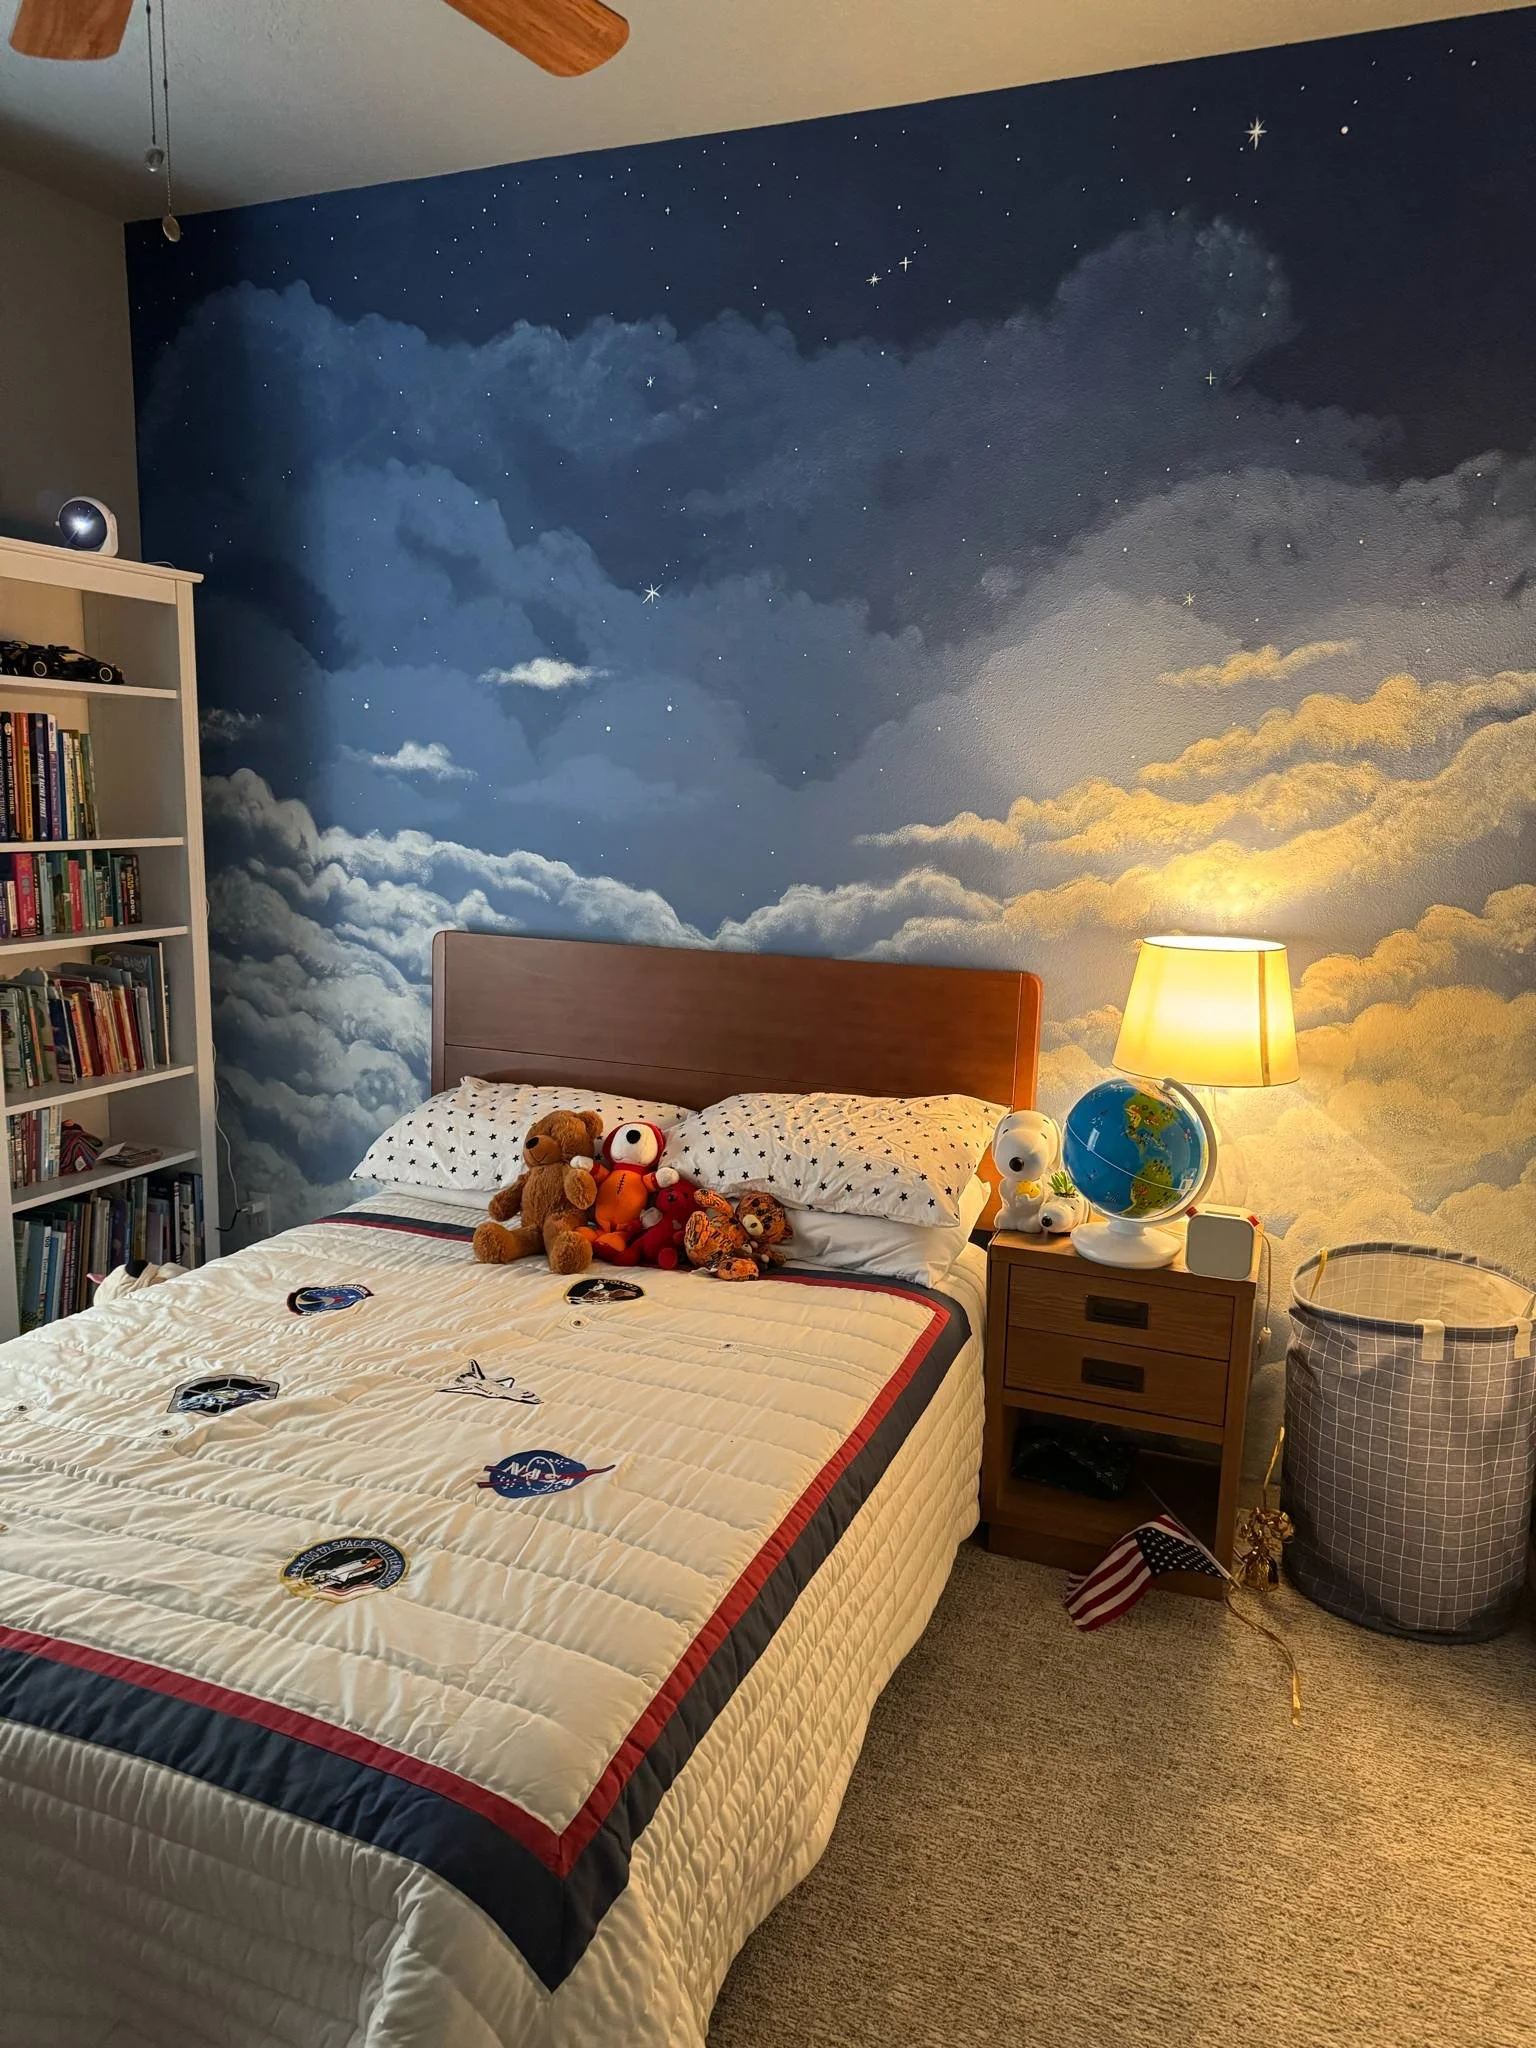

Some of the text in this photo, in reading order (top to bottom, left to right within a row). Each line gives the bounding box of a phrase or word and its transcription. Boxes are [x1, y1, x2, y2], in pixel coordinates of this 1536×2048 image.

[503, 1461, 575, 1486] NASA
[300, 1543, 331, 1562] 100th
[331, 1540, 367, 1549] SPACE
[370, 1540, 401, 1565] SHUTTLE
